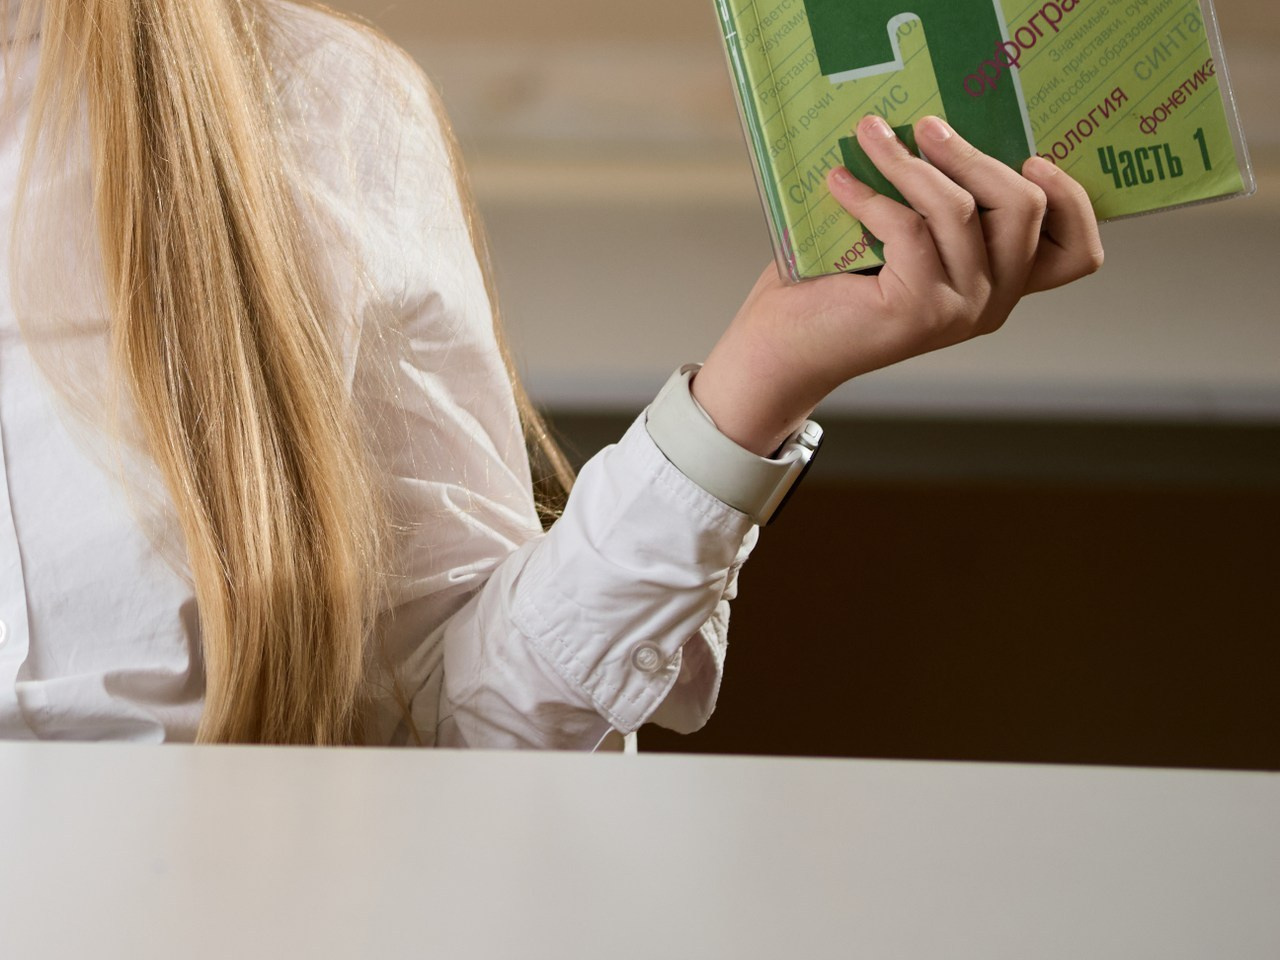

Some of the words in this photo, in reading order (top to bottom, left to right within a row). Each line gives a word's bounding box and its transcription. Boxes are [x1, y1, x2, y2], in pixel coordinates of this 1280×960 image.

[1048, 5, 1110, 62] Значимые
[1133, 6, 1204, 81] синта
[1048, 66, 1100, 115] способы
[1139, 58, 1216, 136] фонетика
[771, 129, 800, 158] асти
[798, 91, 834, 130] речи
[1097, 142, 1183, 190] Часть
[1193, 127, 1212, 171] 1
